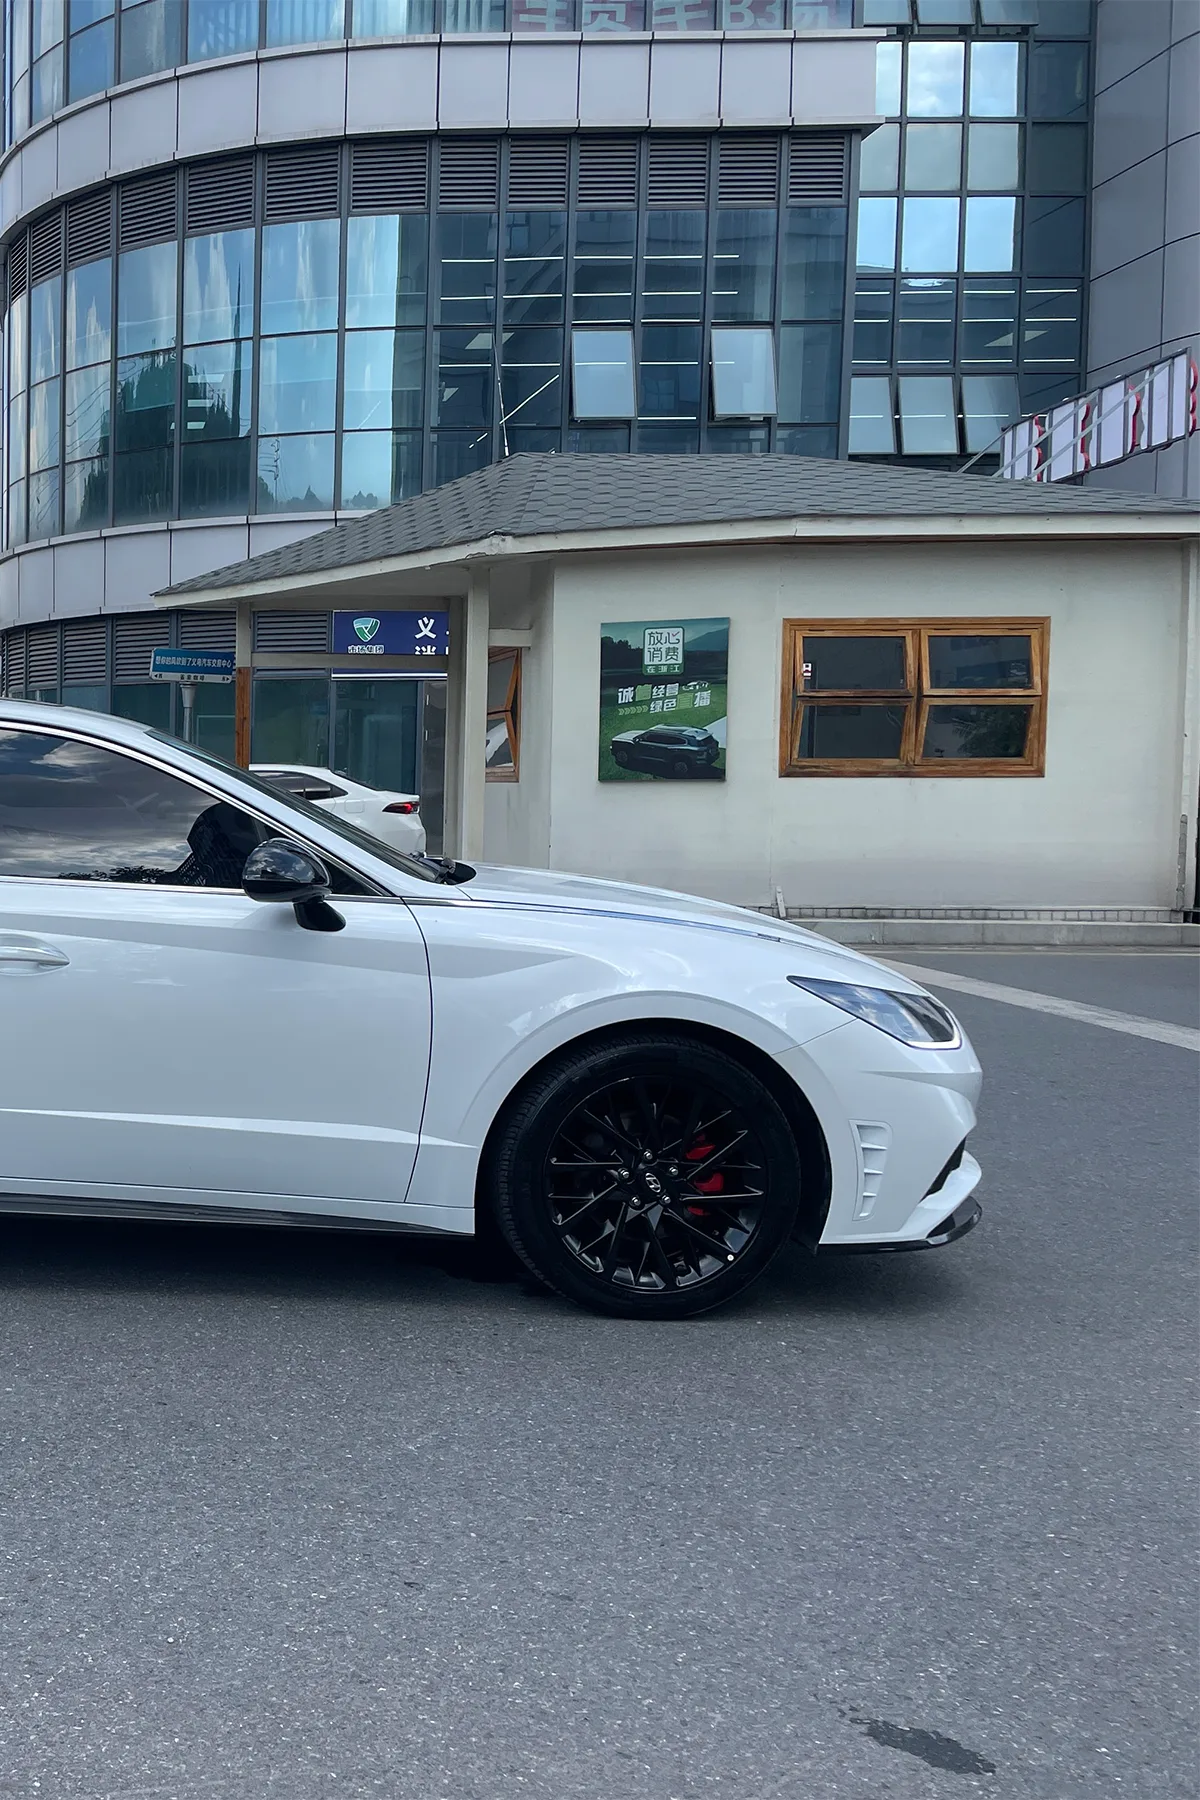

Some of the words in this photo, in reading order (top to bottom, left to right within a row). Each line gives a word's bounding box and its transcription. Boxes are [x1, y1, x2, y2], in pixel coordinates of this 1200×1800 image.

[414, 616, 450, 639] 义
[647, 631, 680, 646] 放心
[647, 647, 679, 662] 消费
[646, 665, 680, 673] 在浙江
